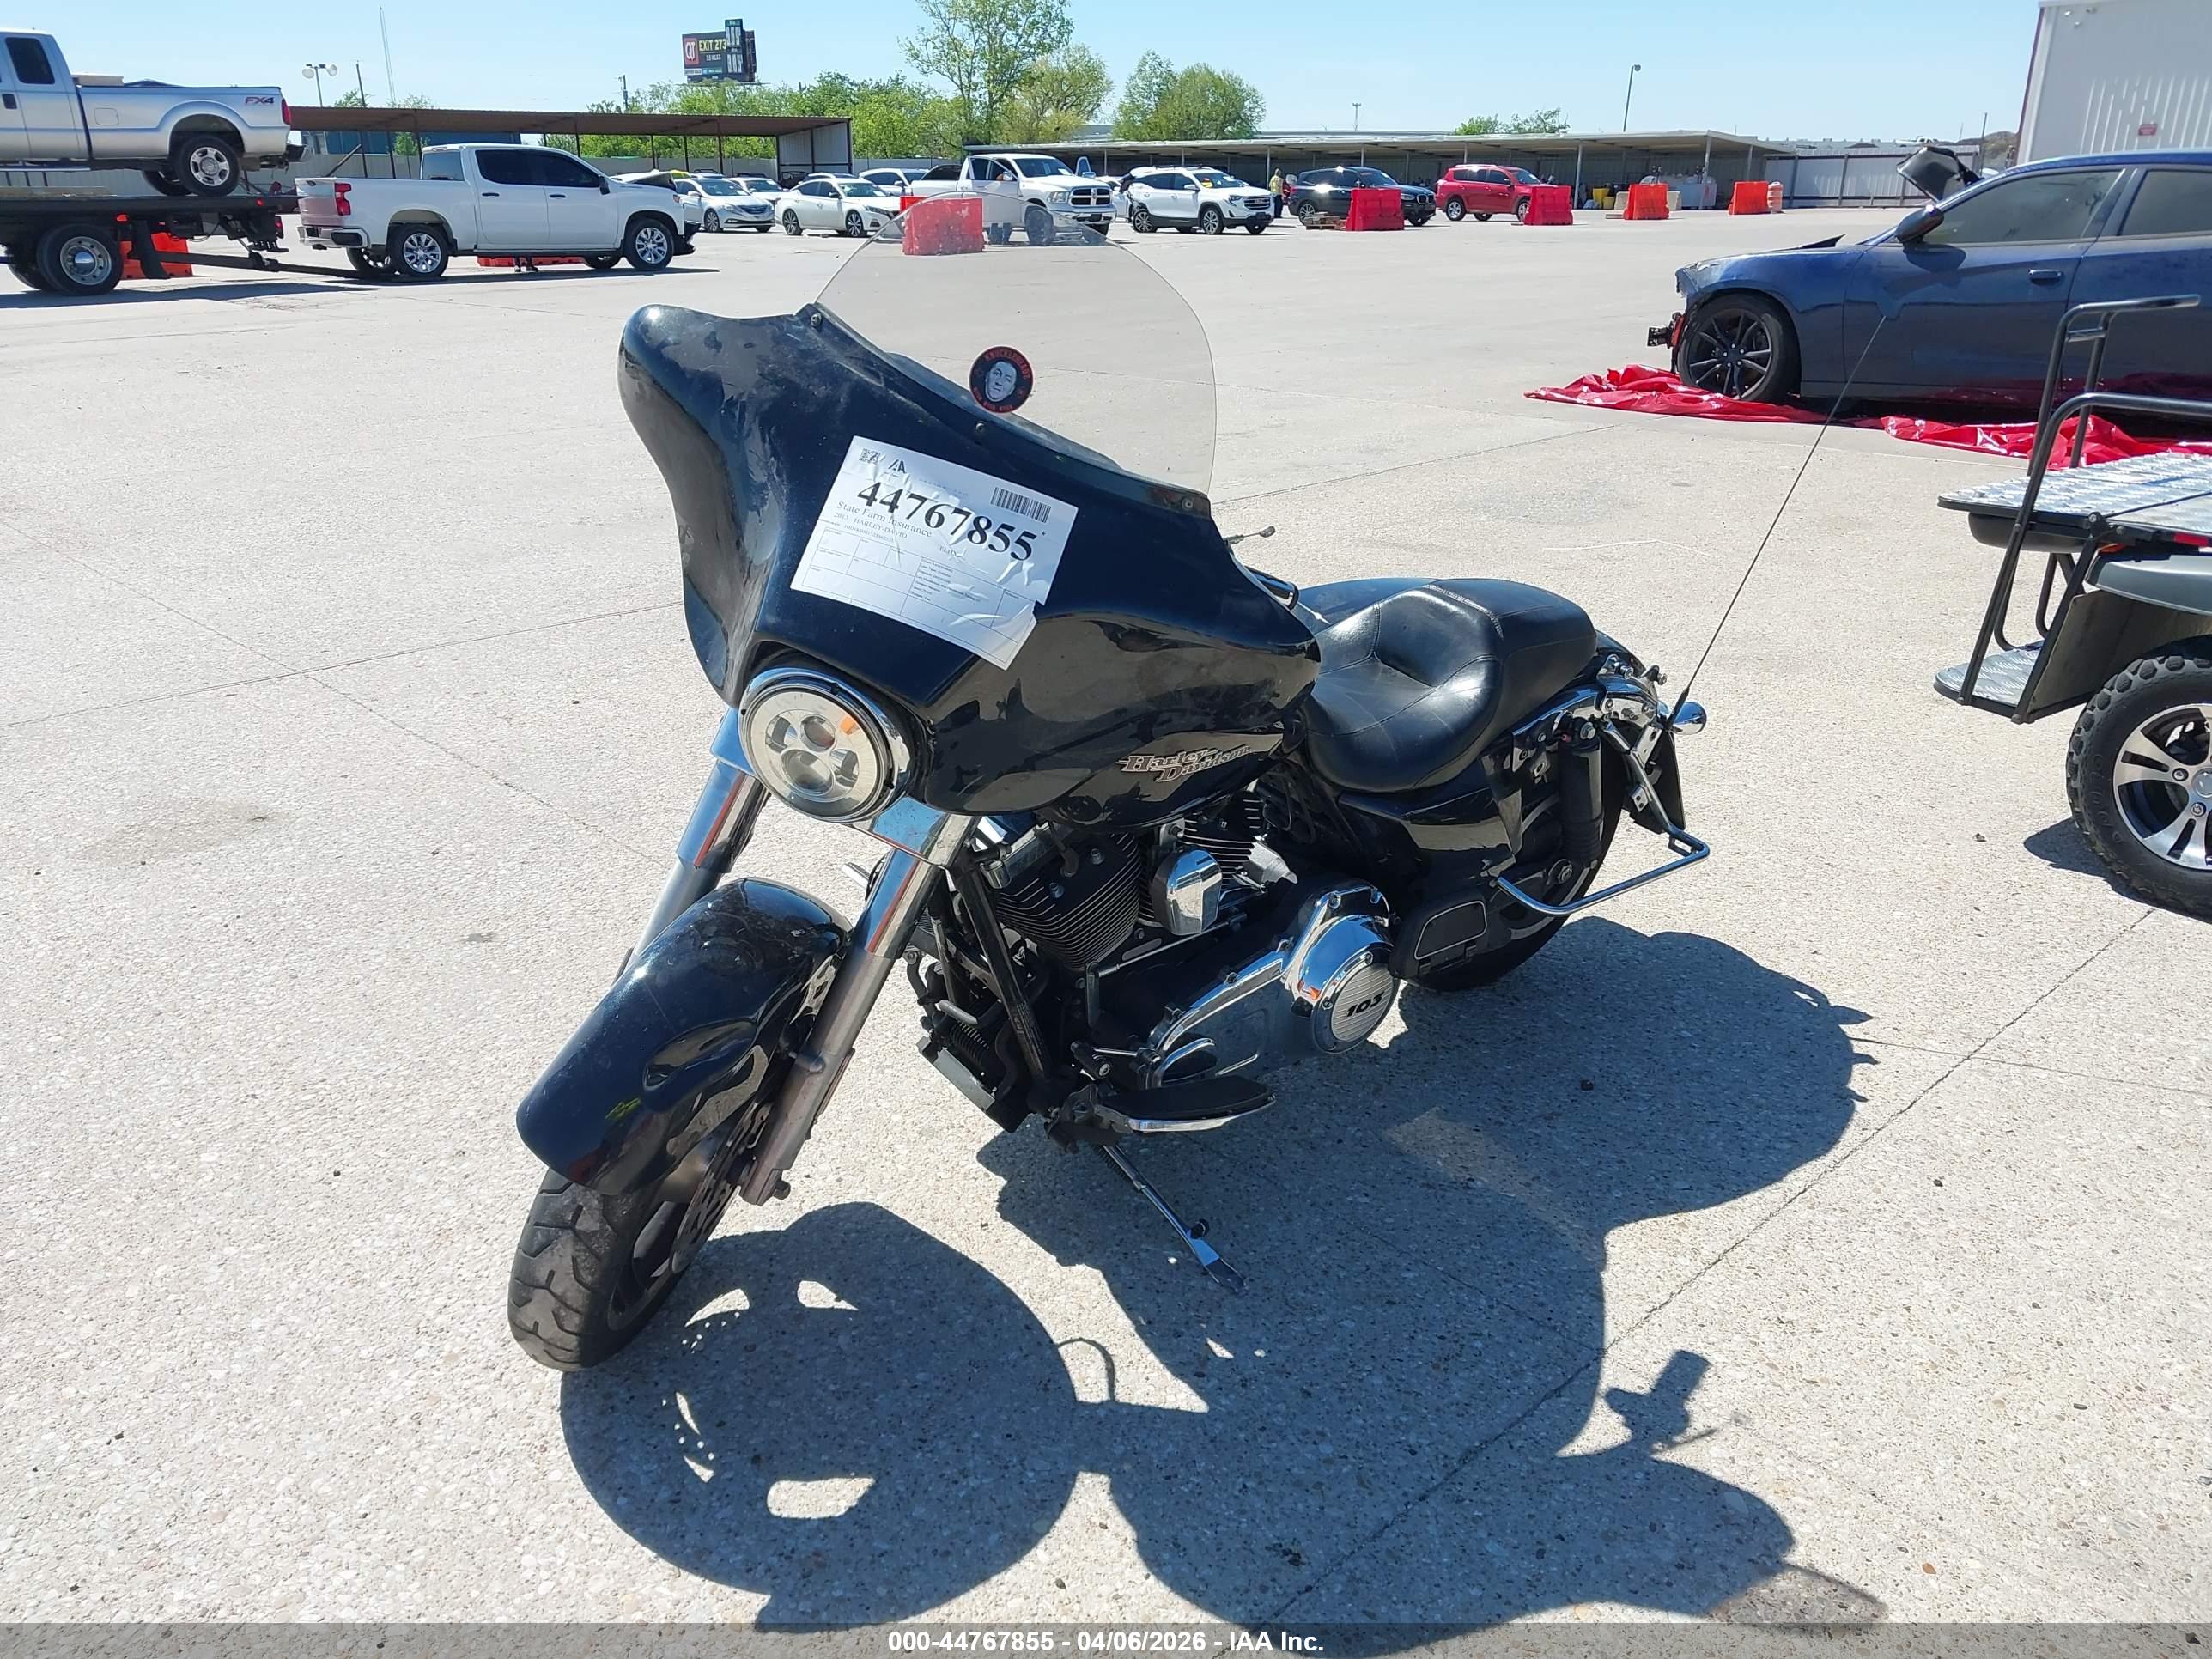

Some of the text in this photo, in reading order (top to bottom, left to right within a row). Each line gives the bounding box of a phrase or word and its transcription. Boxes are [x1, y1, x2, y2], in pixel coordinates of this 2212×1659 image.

[685, 41, 696, 62] QT
[698, 38, 726, 52] EXIT 273
[836, 501, 860, 514] State
[861, 507, 886, 523] Farm
[888, 515, 933, 538] Insurance
[857, 482, 1037, 561] 44767855
[1155, 744, 1252, 782] Davidson
[1346, 991, 1385, 1018] 103
